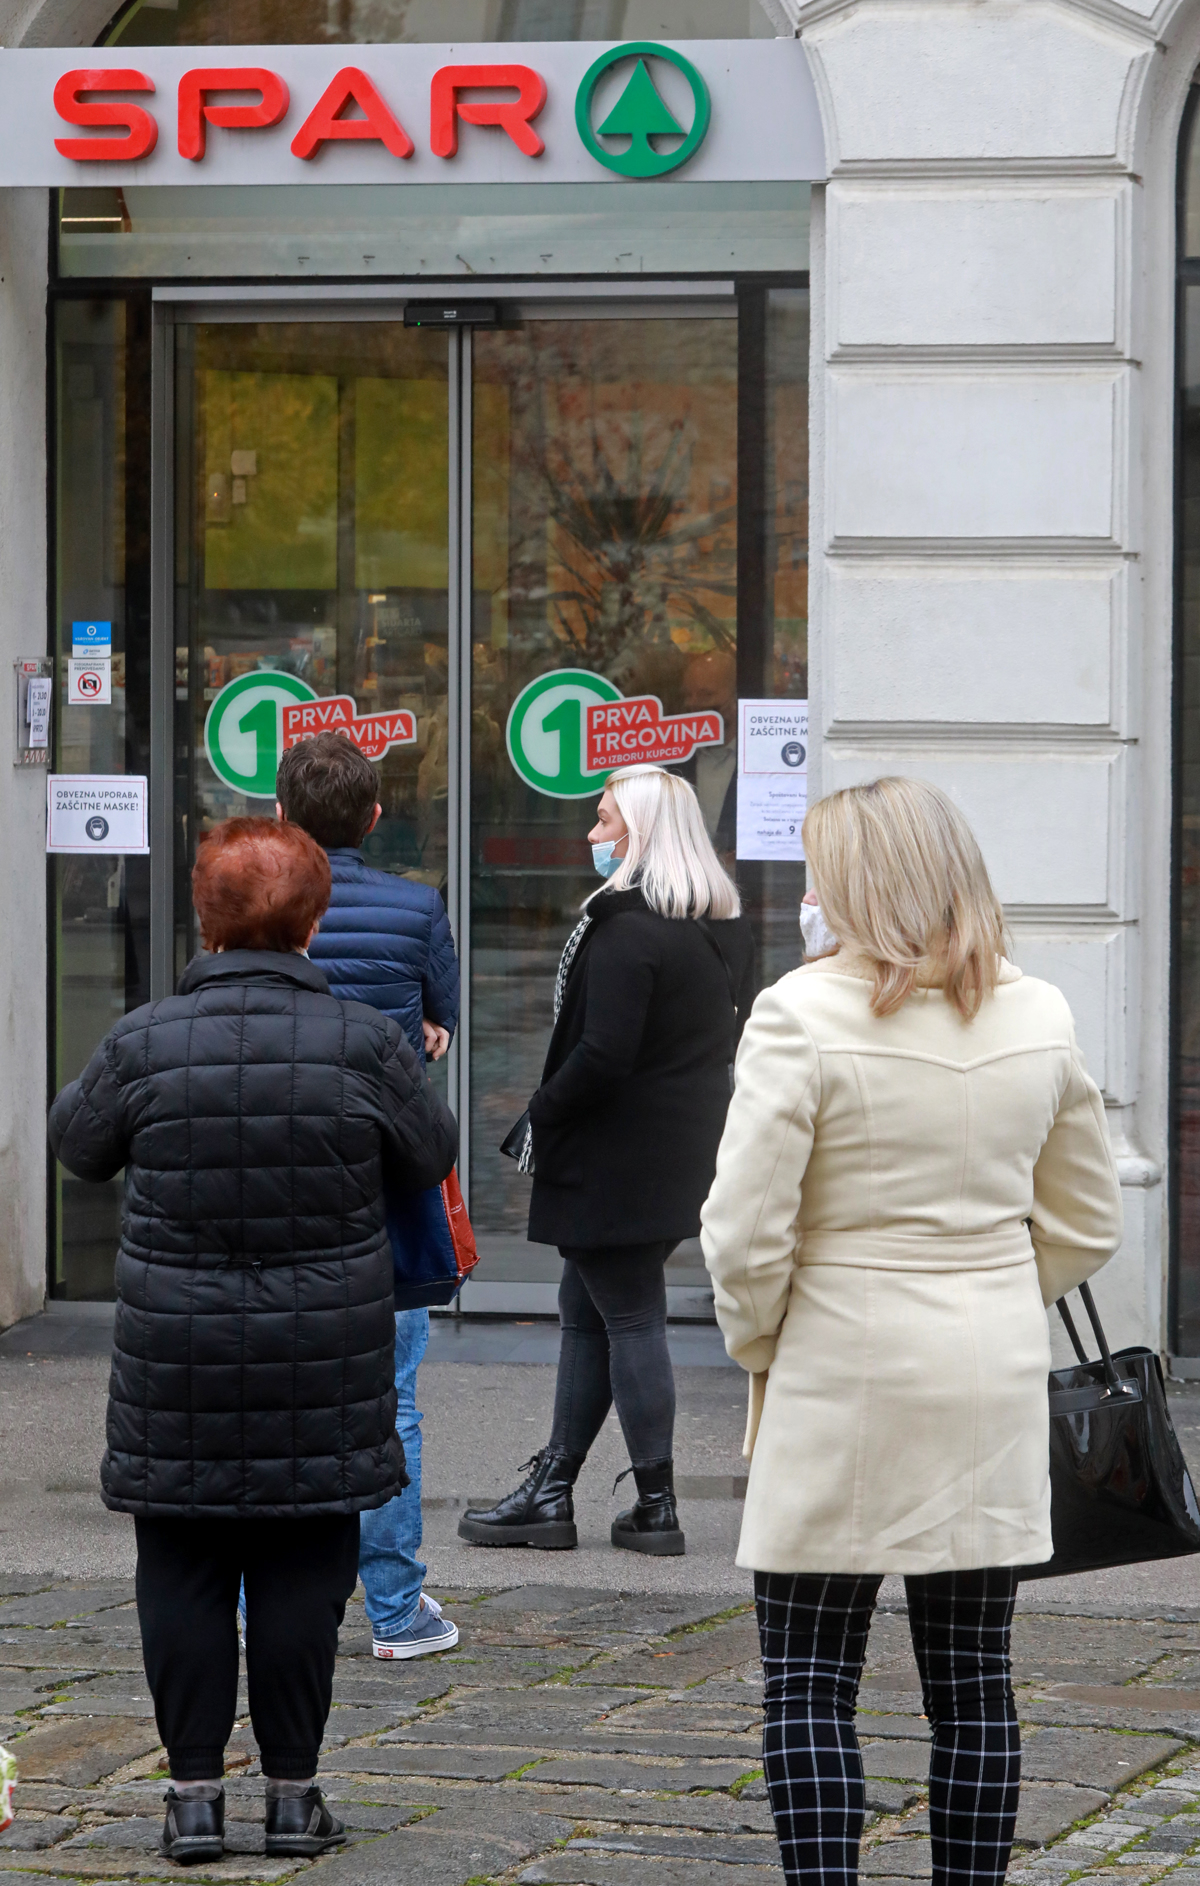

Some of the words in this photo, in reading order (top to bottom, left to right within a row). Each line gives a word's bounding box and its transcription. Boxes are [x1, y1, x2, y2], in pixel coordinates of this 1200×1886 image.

[53, 64, 548, 161] SPAR
[288, 704, 346, 729] PRVA
[592, 704, 652, 729] PRVA
[750, 716, 792, 724] OBVEZNA
[592, 720, 714, 752] TRGOVINA
[750, 725, 798, 736] ZAŠČITNE
[592, 756, 607, 766] PO
[608, 751, 644, 764] IZBORU
[646, 746, 685, 759] KUPCEV
[56, 790, 96, 799] OBVEZNA
[98, 791, 139, 799] UPORABA
[56, 800, 101, 811] ZAŠČITNE
[103, 802, 139, 811] MASKE!
[789, 825, 795, 835] 9
